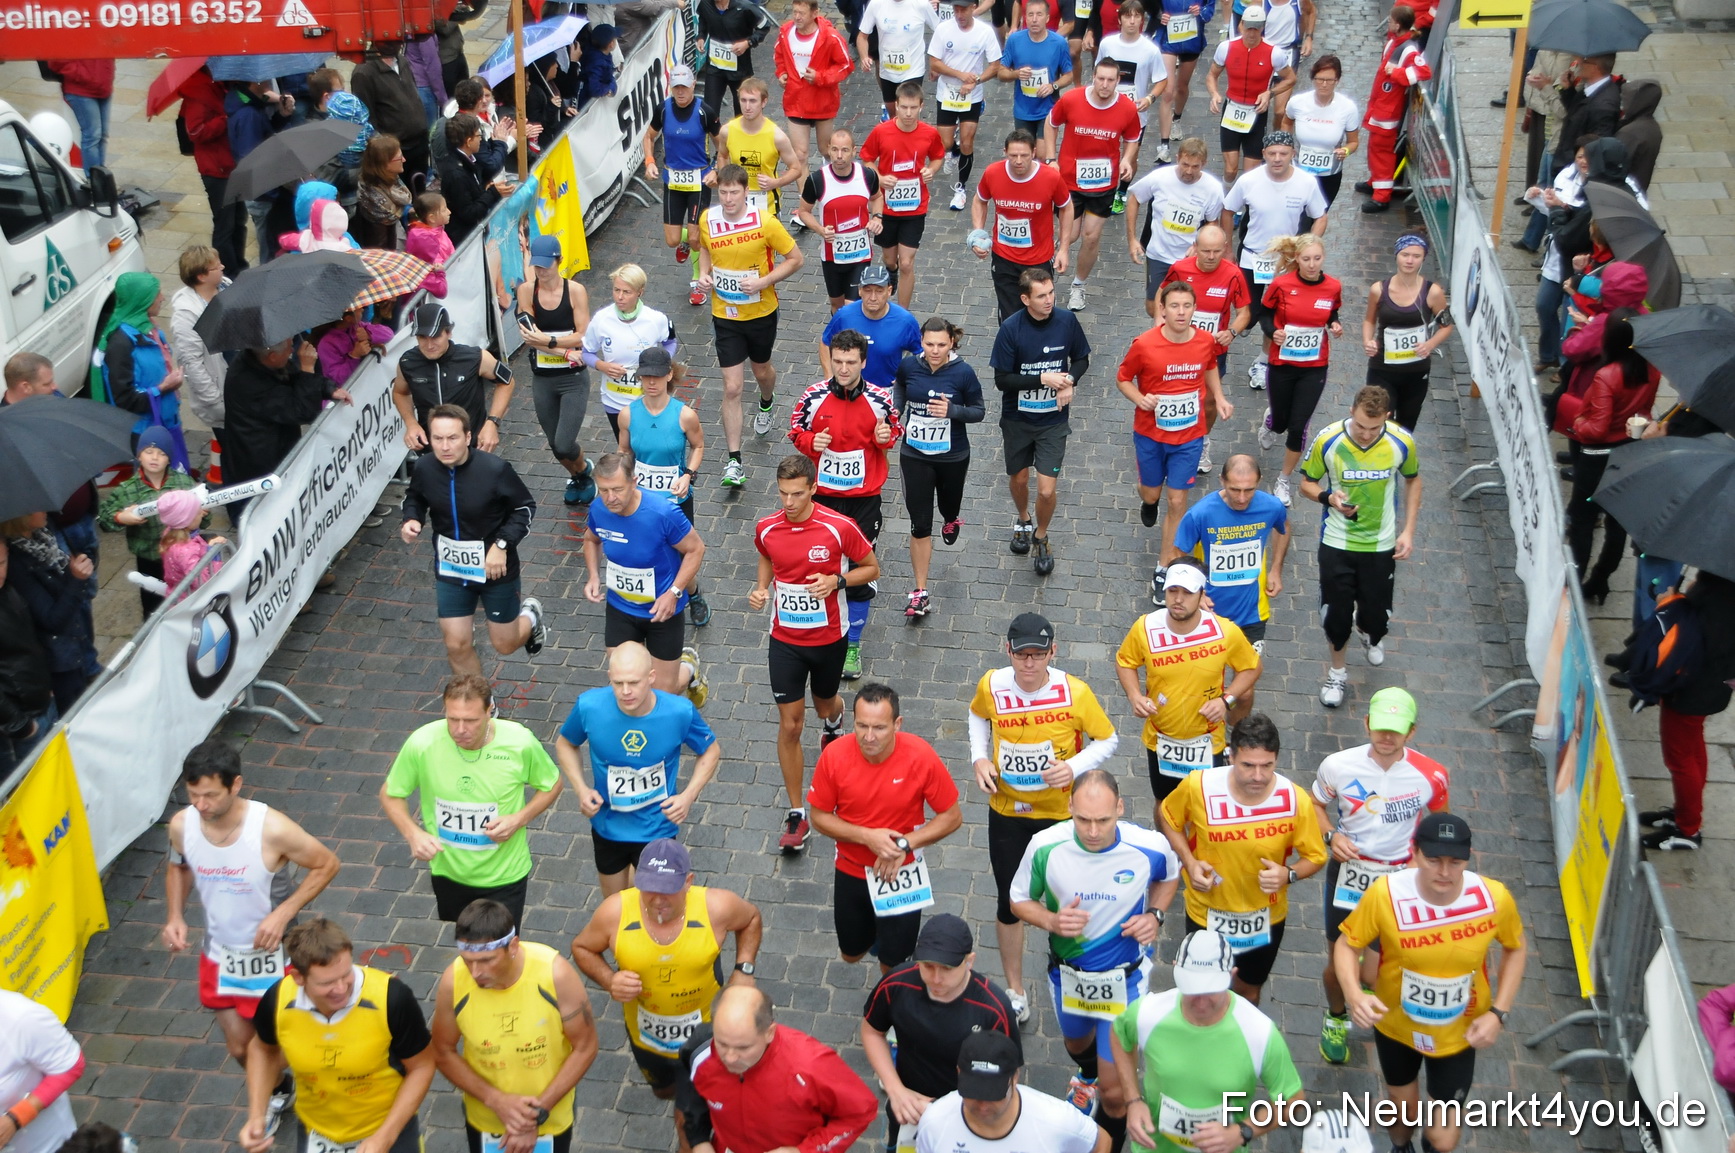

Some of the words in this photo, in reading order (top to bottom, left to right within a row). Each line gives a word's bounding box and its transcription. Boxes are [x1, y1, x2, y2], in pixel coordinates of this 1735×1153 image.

[100, 2, 181, 28] 09181
[191, 0, 263, 25] 6352
[1173, 20, 1191, 33] 577
[714, 47, 731, 61] 570
[887, 54, 905, 65] 178
[1233, 109, 1247, 121] 60
[1074, 126, 1112, 138] NEUMARKT
[1301, 152, 1330, 167] 2950
[673, 170, 694, 184] 335
[1080, 166, 1108, 180] 2381
[887, 184, 918, 200] 2322
[994, 198, 1035, 210] NEUMARKT
[1171, 209, 1194, 226] 168
[1000, 221, 1027, 238] 2379
[710, 238, 735, 250] MAX
[736, 231, 765, 246] BÖGL
[836, 236, 867, 253] 2273
[1285, 334, 1319, 349] 2633
[1393, 335, 1418, 350] 189
[1162, 372, 1198, 382] Neumarkt
[1166, 363, 1202, 374] Klinikum
[1022, 388, 1057, 401] 3176
[1159, 401, 1195, 418] 2343
[911, 426, 946, 441] 3177
[823, 459, 861, 477] 2138
[1342, 469, 1391, 481] BOCK
[637, 472, 674, 490] 2137
[828, 476, 853, 486] Mathias
[1207, 527, 1217, 535] 10.
[1217, 521, 1266, 535] NEUMARKTER
[1216, 530, 1257, 541] STADTLAUF
[247, 566, 300, 638] Wenige
[299, 482, 359, 568] Verbrauch.
[356, 438, 384, 488] Mehr
[244, 516, 297, 604] BMW
[442, 546, 481, 566] 2505
[1215, 551, 1257, 571] 2010
[622, 570, 646, 578] Neumarkt
[1226, 571, 1245, 581] Klaus
[615, 574, 645, 594] 554
[780, 592, 820, 612] 2555
[787, 613, 814, 623] Thomas
[1151, 653, 1186, 668] MAX
[1189, 643, 1227, 662] BÖGL
[997, 716, 1030, 729] MAX
[1034, 711, 1075, 726] BÖGL
[1161, 743, 1208, 764] 2907
[1003, 753, 1050, 773] 2852
[614, 771, 662, 796] 2115
[1016, 775, 1042, 785] Stefan
[1385, 795, 1422, 813] ROTHSEE
[441, 810, 491, 832] 2114
[453, 834, 479, 845] Armin
[1208, 829, 1249, 843] MAX
[1254, 822, 1296, 840] BÖGL
[1344, 868, 1380, 891] 29
[886, 892, 922, 910] Christian
[1074, 891, 1118, 902] Mathias
[1214, 915, 1265, 936] 2980
[1400, 932, 1445, 950] MAX
[1450, 920, 1498, 942] BÖGL
[225, 954, 277, 977] 3105
[1074, 983, 1114, 1001] 428
[1425, 979, 1462, 989] Neumarkt
[1407, 982, 1464, 1008] 2914
[1077, 999, 1112, 1013] Mathias
[1415, 1006, 1455, 1020] Andreas
[642, 1018, 694, 1040] 2890
[1174, 1116, 1218, 1136] 45
